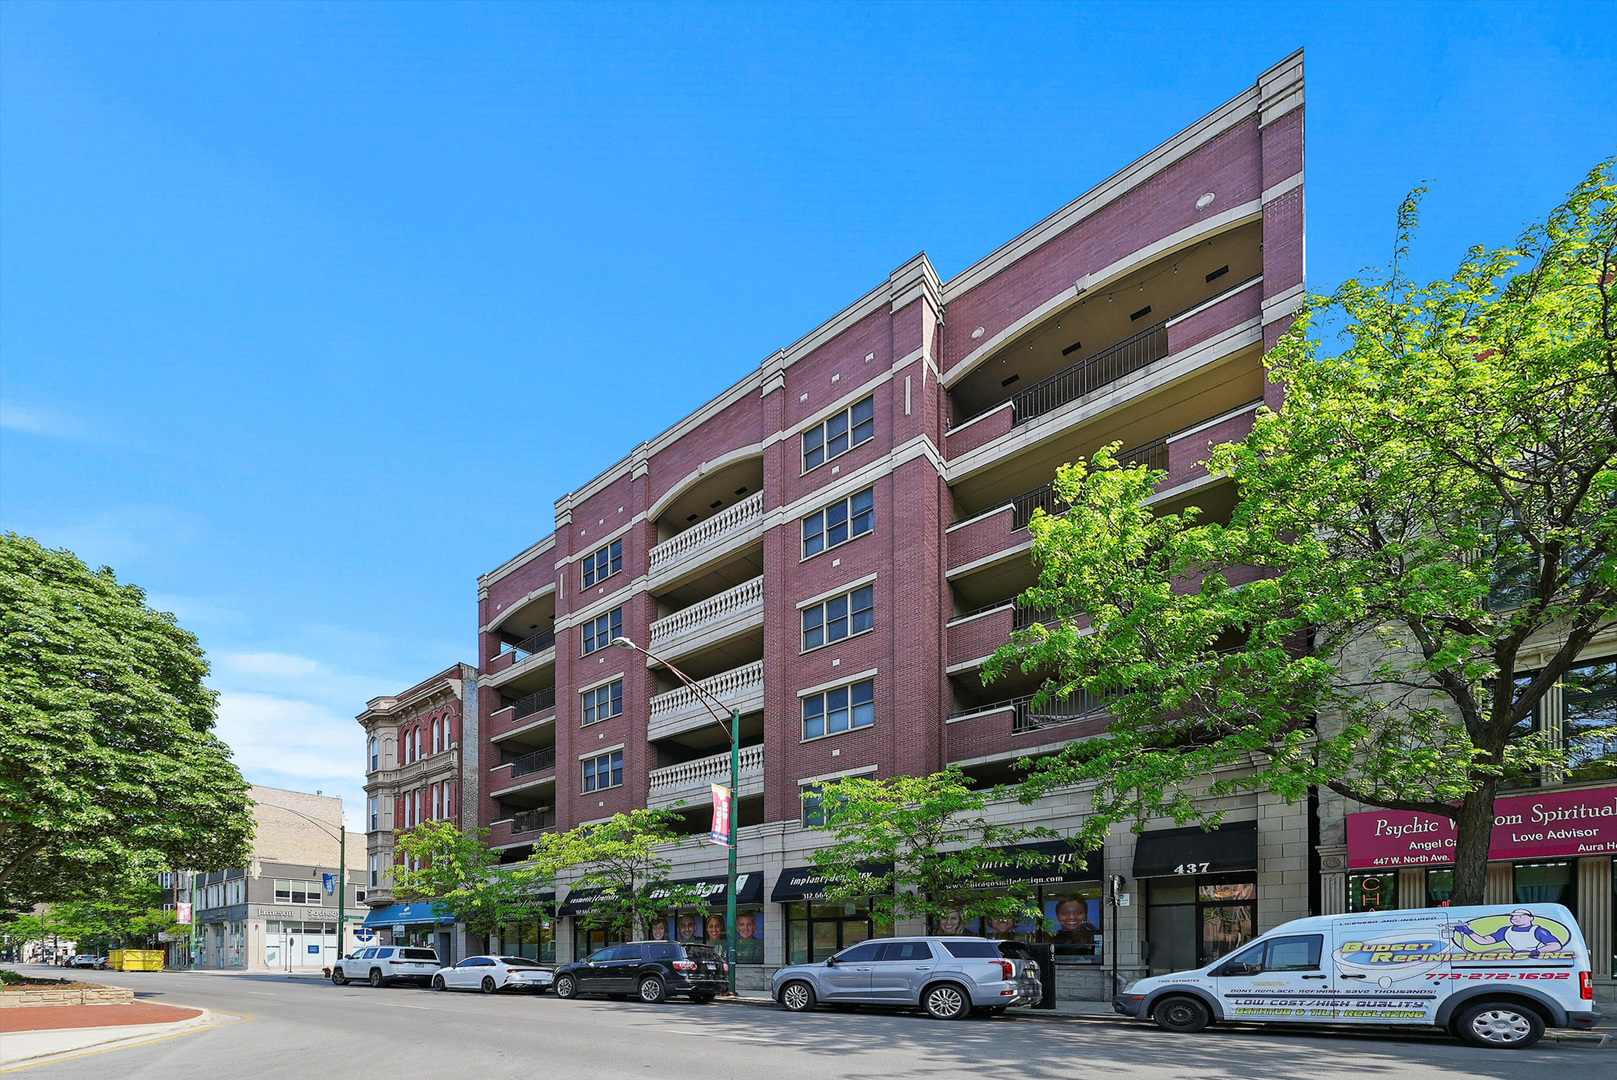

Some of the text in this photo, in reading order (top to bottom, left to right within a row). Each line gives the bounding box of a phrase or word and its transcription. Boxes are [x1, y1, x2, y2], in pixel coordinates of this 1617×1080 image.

[1374, 816, 1439, 838] Psychic
[1531, 796, 1617, 826] Spiritual
[1512, 828, 1600, 842] Love Advisor
[1409, 839, 1442, 851] Angel
[1577, 842, 1604, 852] Aura
[1373, 853, 1450, 865] 447 W. North Ave.
[1173, 861, 1210, 875] 437
[256, 908, 294, 918] Jameson
[1341, 941, 1434, 953] BUDGET
[1370, 951, 1531, 963] REFINISHERS
[1234, 1007, 1293, 1016] BATHTUB
[1310, 1008, 1341, 1016] TILE
[1343, 1009, 1427, 1018] REGLAZING
